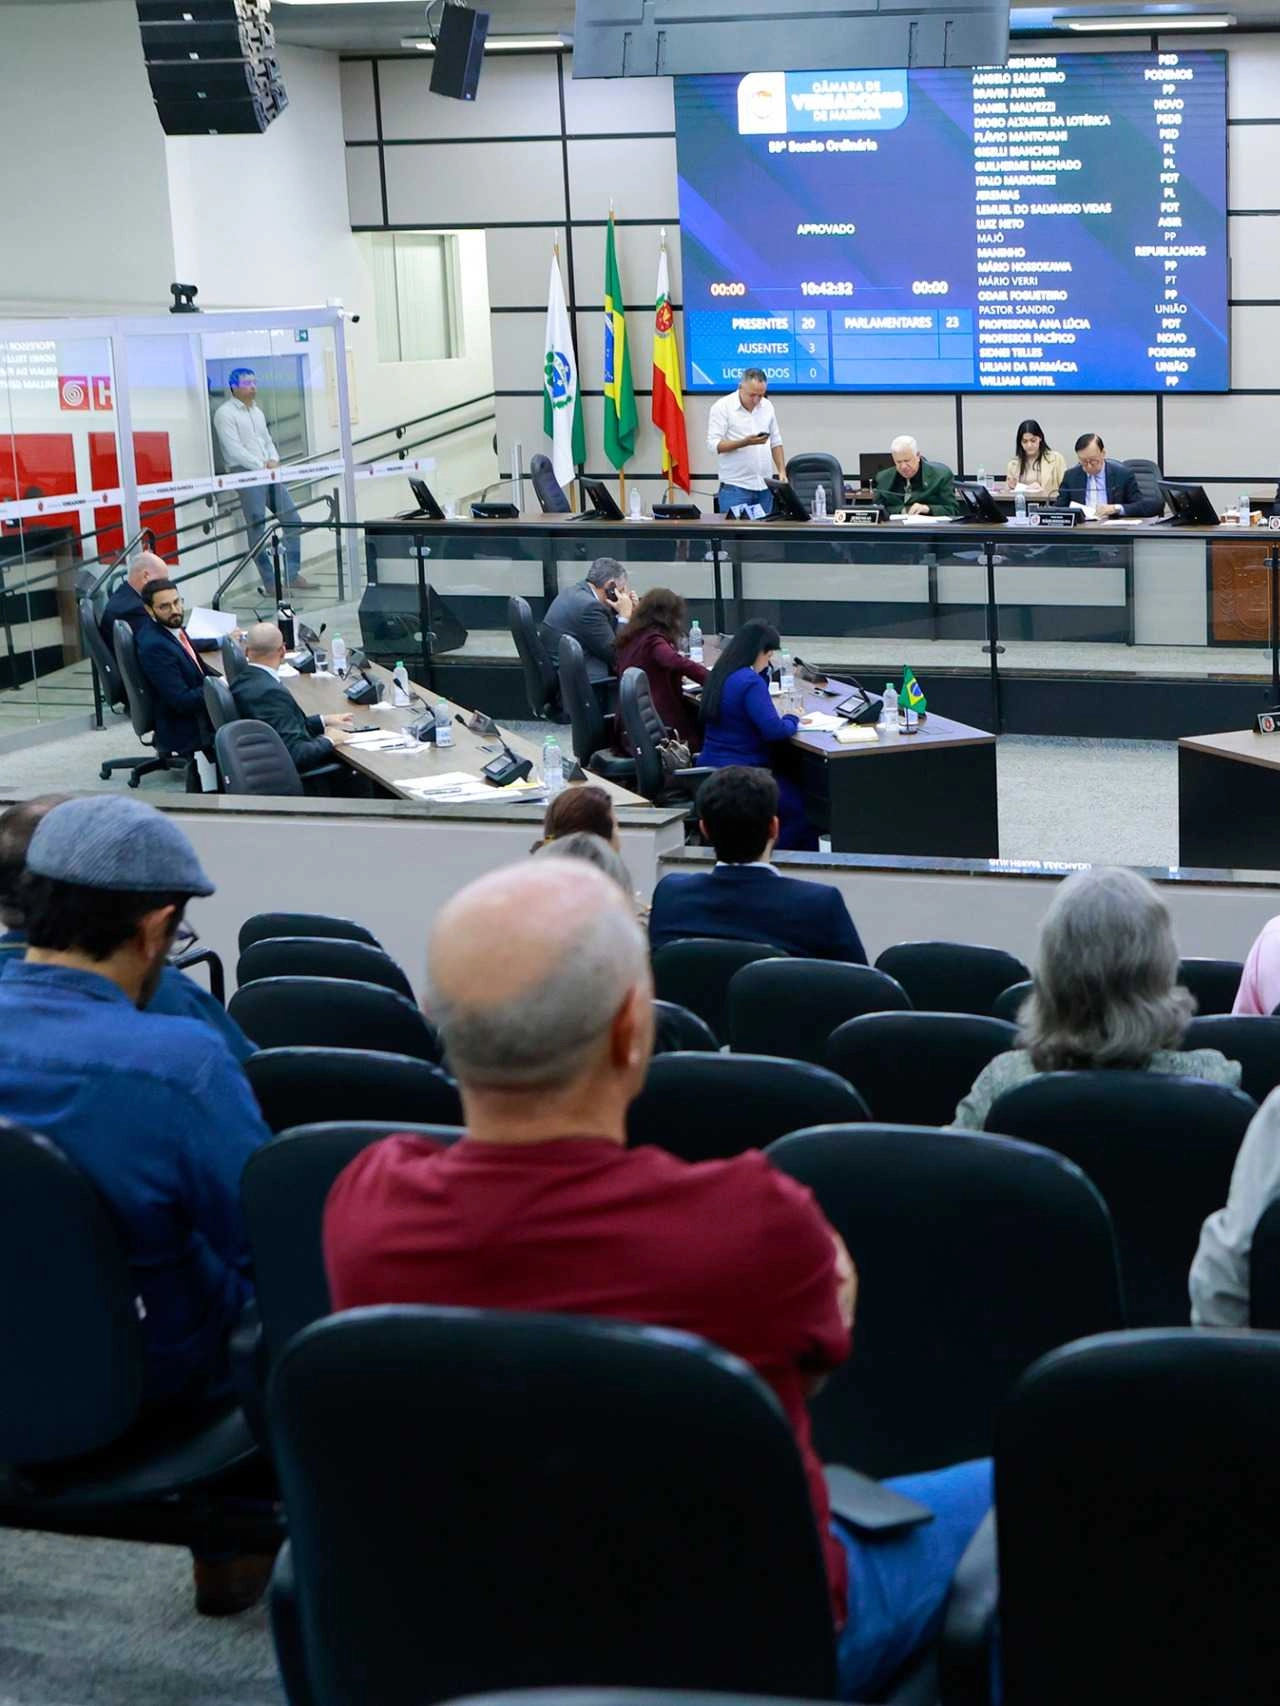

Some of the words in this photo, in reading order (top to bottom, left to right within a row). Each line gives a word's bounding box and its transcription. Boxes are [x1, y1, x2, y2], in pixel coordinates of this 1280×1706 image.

[1145, 69, 1193, 80] PODEMOS
[1011, 87, 1045, 98] JUNIOR
[1163, 84, 1175, 94] PP
[974, 103, 1008, 113] DANIEL
[1154, 99, 1184, 109] NOVO
[975, 118, 1006, 128] DIOGO
[1050, 117, 1064, 126] DA
[1009, 131, 1067, 141] MANTOVANI
[1164, 144, 1175, 153] PL
[1031, 160, 1081, 170] MACHADO
[1164, 159, 1175, 168] PL
[1164, 188, 1175, 197] PL
[1014, 204, 1029, 214] DO
[1082, 203, 1111, 213] VIDAS
[798, 224, 854, 234] APROVADO
[999, 219, 1024, 229] NETO
[978, 232, 1003, 242] MAJÔ
[1165, 232, 1176, 240] PP
[977, 248, 1025, 257] MANINHO
[1135, 246, 1206, 256] REPUBLICANOS
[978, 261, 1009, 272] MÁRIO
[1165, 261, 1177, 270] PP
[979, 276, 1009, 285] MÁRIO
[1012, 277, 1037, 285] VERRI
[710, 283, 746, 297] 00:00
[912, 280, 949, 295] 00:00
[1165, 290, 1177, 299] PP
[979, 305, 1013, 314] PASTOR
[1016, 306, 1055, 314] SANDRO
[1156, 303, 1187, 313] UNIÃO
[732, 318, 789, 330] PRESENTES
[801, 318, 816, 329] 20
[844, 317, 933, 329] PARLAMENTARES
[945, 317, 960, 328] 23
[979, 319, 1038, 329] PROFESSORA
[1039, 319, 1061, 329] ANA
[1063, 318, 1090, 329] LÚCIA
[1162, 319, 1181, 328] PDT
[980, 333, 1031, 343] PROFESSOR
[1157, 333, 1186, 342] NOVO
[737, 343, 790, 354] AUSENTES
[1012, 348, 1042, 357] TELLES
[1149, 348, 1195, 357] PODEMOS
[1013, 362, 1027, 371] DA
[1029, 360, 1077, 371] FARMÁCIA
[1156, 361, 1188, 371] UNIÃO
[722, 367, 791, 379] LICEADOS
[1167, 376, 1178, 385] PP
